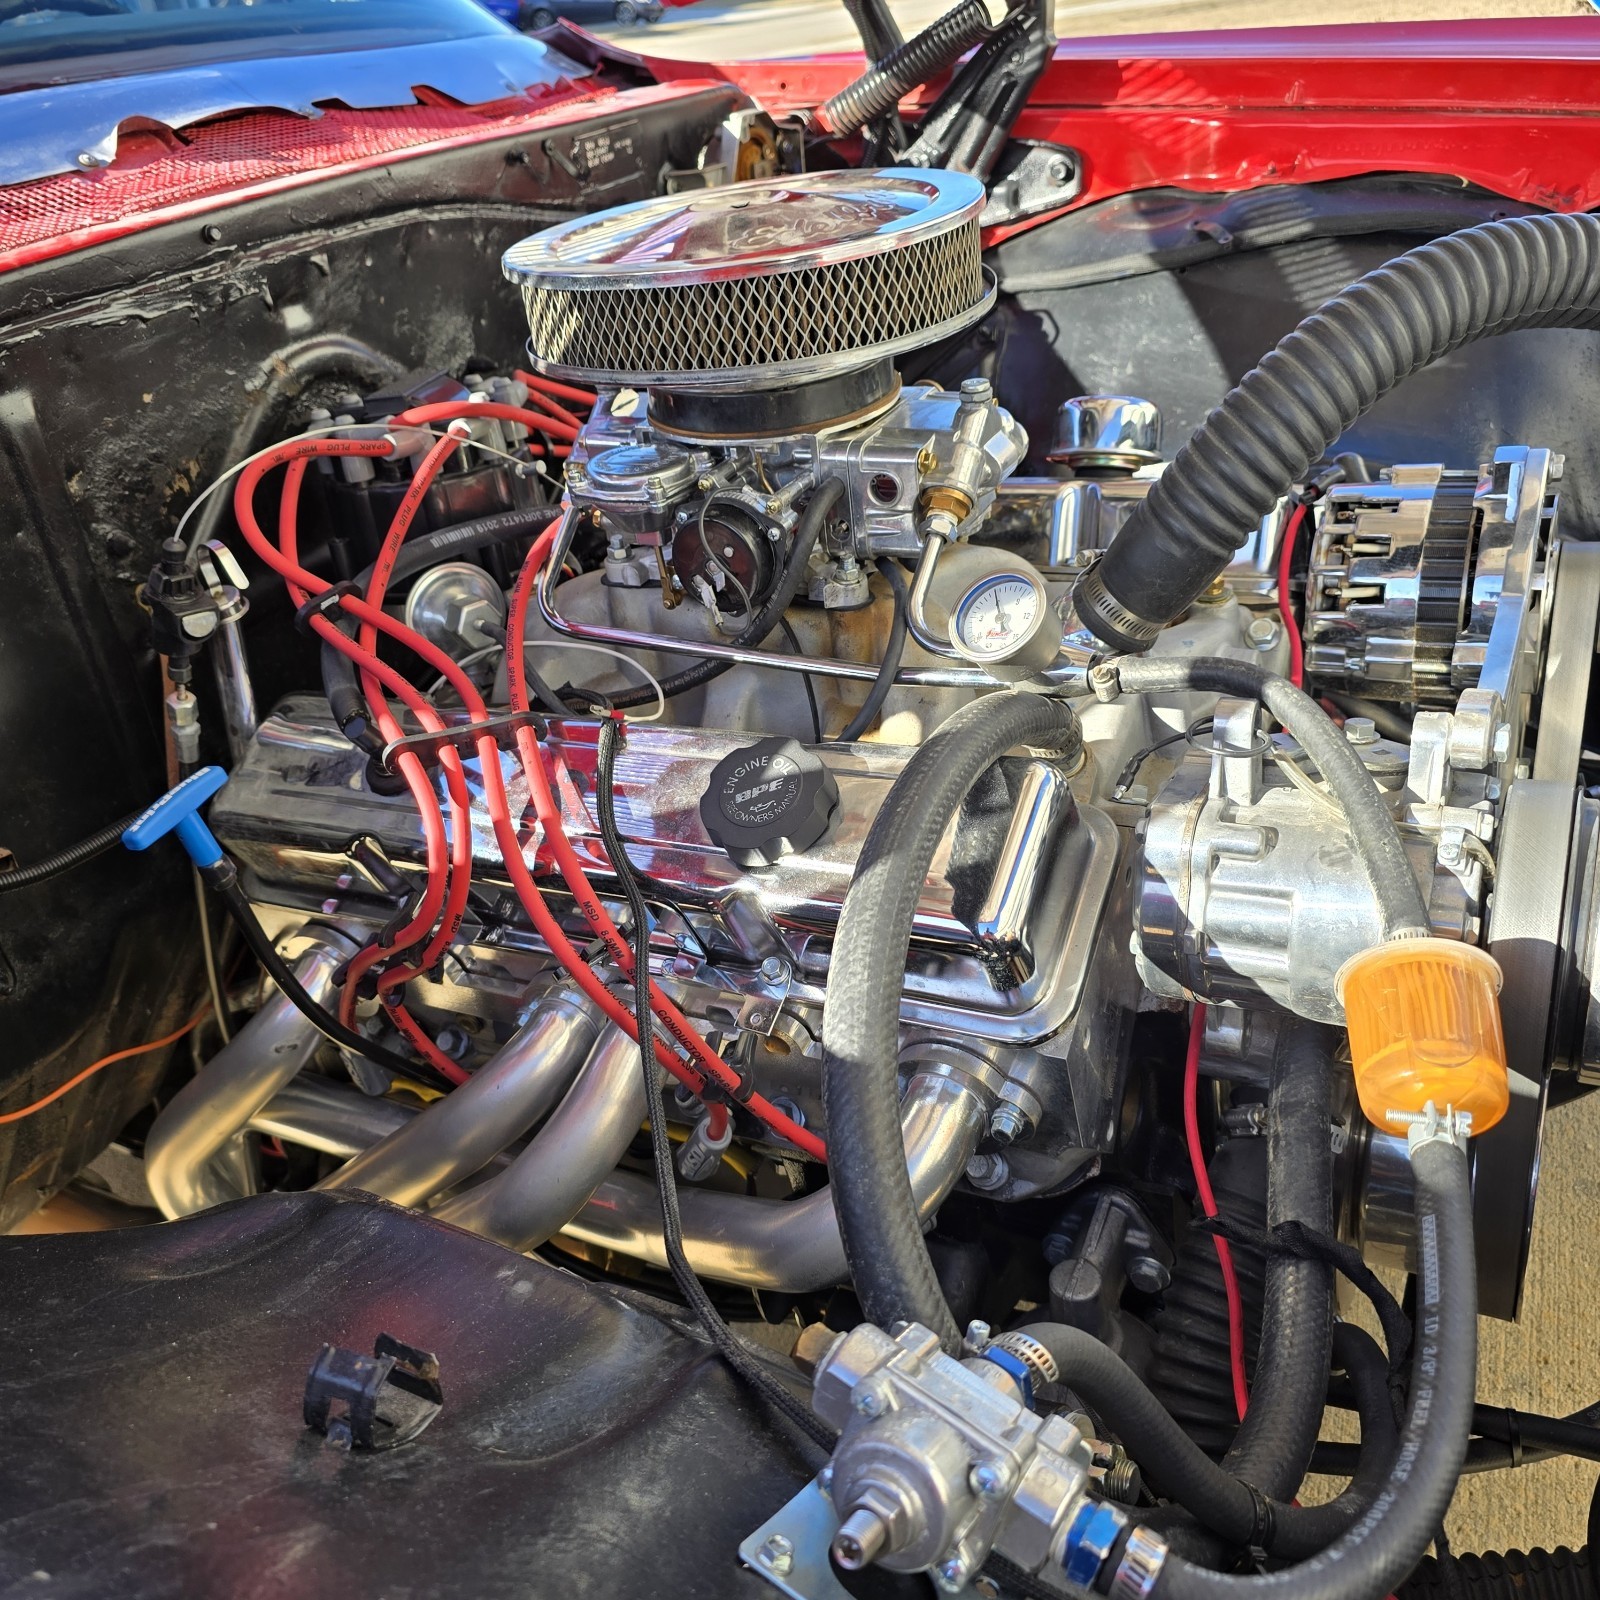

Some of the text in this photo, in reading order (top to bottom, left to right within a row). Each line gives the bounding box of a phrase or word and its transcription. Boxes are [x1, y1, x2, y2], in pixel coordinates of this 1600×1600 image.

[295, 443, 387, 456] SPARK PLUG WIRE
[400, 505, 412, 527] PLUG
[476, 520, 500, 533] 2019
[389, 532, 401, 553] WIRE
[509, 598, 518, 618] SUPER
[507, 623, 515, 660] CONDUCTOR
[507, 666, 516, 689] SPARK
[511, 693, 520, 712] PLUG
[724, 756, 794, 794] ENGINE OIL
[734, 810, 775, 823] OWNERS
[774, 778, 798, 816] MANUAL
[735, 778, 784, 804] BPE
[450, 912, 462, 934] MSD
[583, 900, 600, 922] MSD
[600, 929, 625, 960] 8.5MM
[657, 1008, 706, 1063] CONDUCTOR
[1424, 1315, 1439, 1335] ID
[1421, 1345, 1437, 1377] 3/8"
[1391, 1442, 1420, 1483] HOSE
[1344, 1491, 1396, 1546] 300PSI
